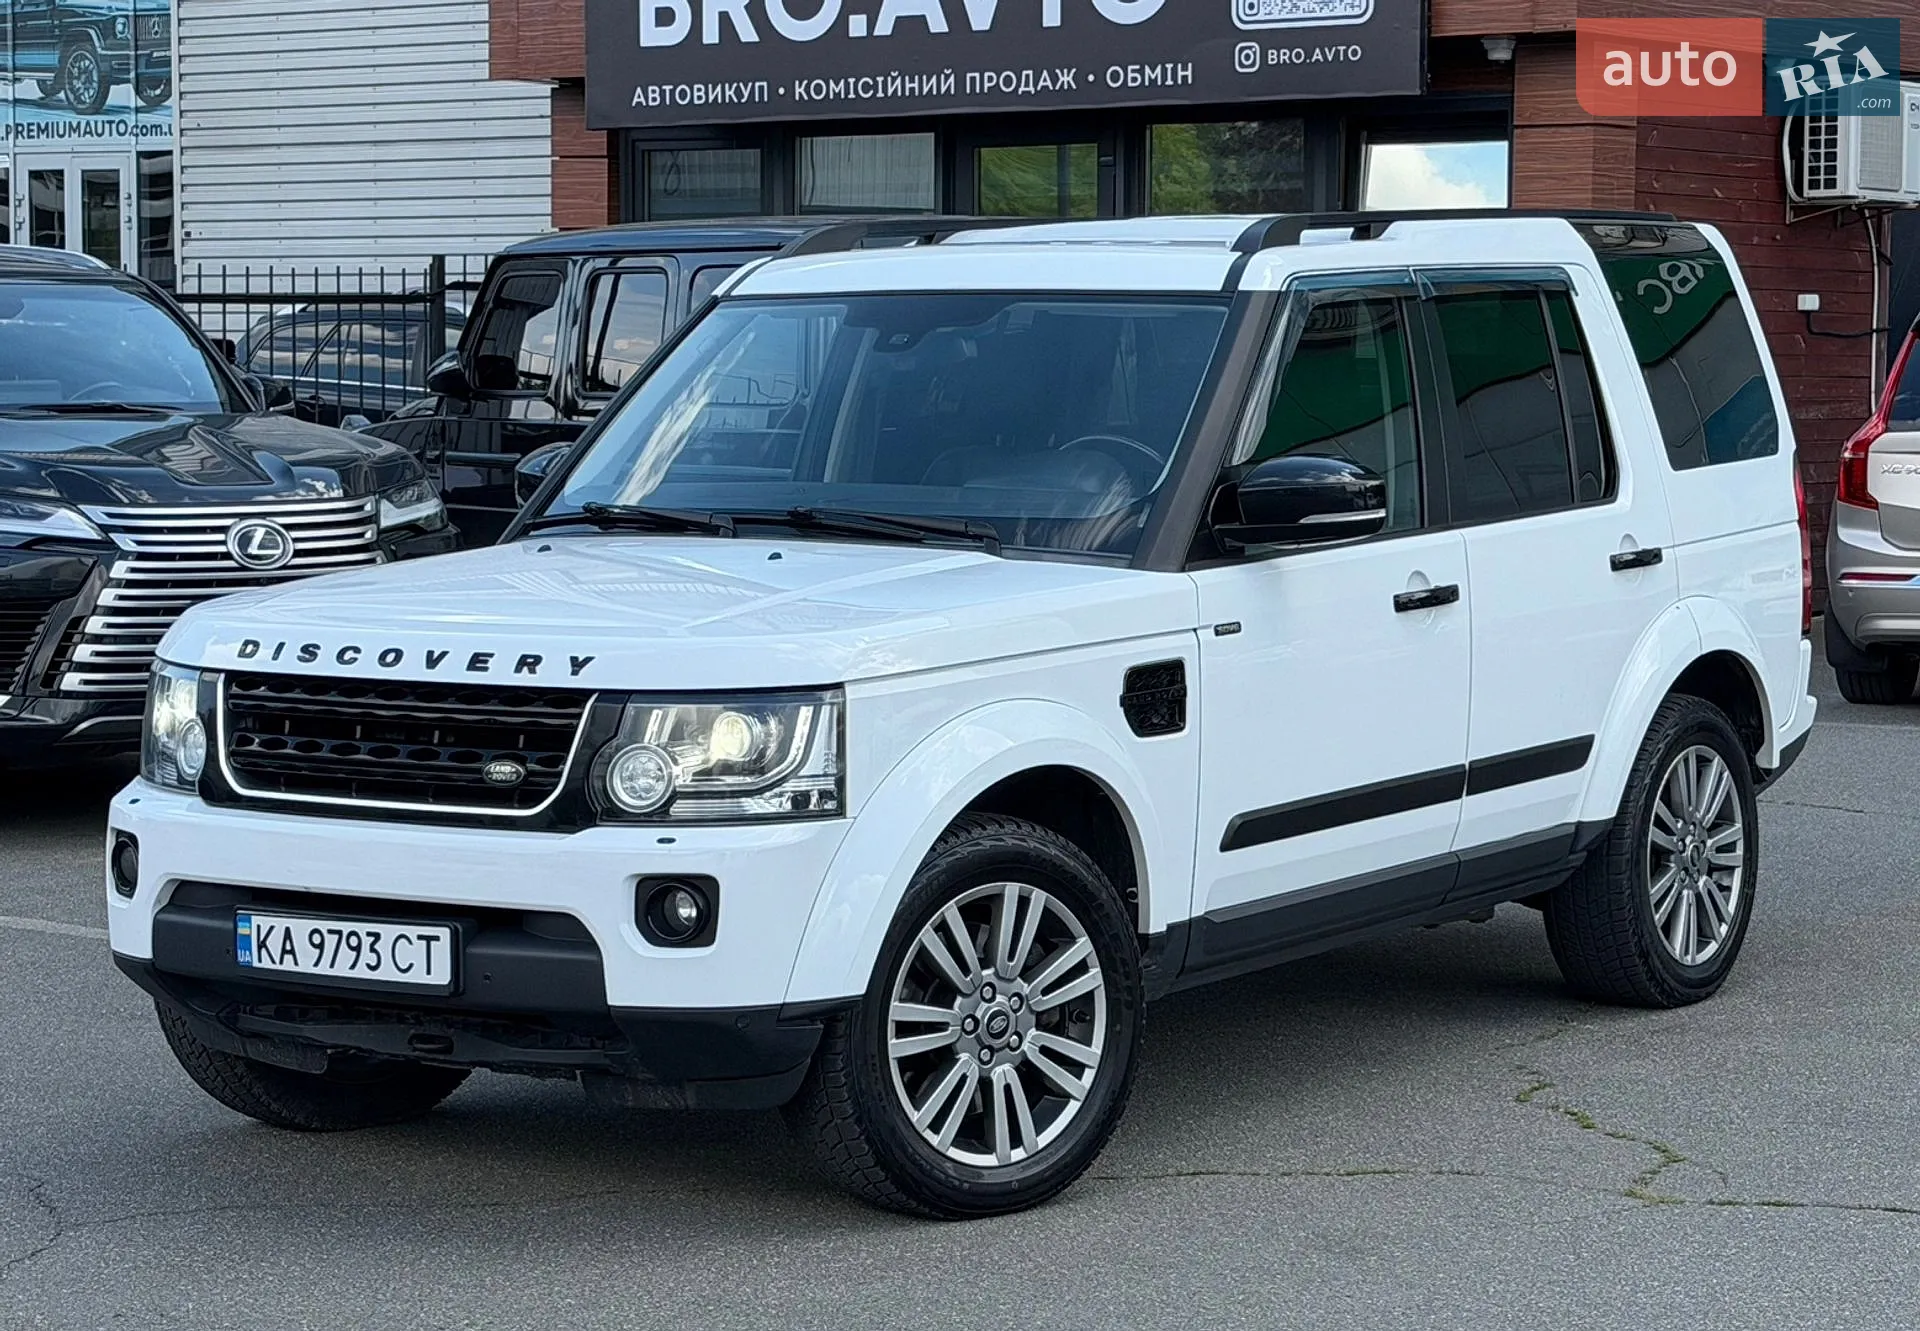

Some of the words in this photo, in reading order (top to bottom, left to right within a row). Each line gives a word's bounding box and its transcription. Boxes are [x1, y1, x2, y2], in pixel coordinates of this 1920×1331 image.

[1267, 45, 1362, 65] BRO.AVTO
[631, 81, 768, 107] АВТОВИКУП
[795, 68, 955, 101] КОМІСІЙНИЙ
[966, 67, 1077, 95] ПРОДАЖ
[1106, 62, 1193, 89] ОБМІН
[237, 638, 595, 677] DISCOVERY
[237, 949, 251, 962] UA
[256, 924, 299, 967] KA
[308, 927, 382, 972] 9793
[391, 933, 441, 976] CT
